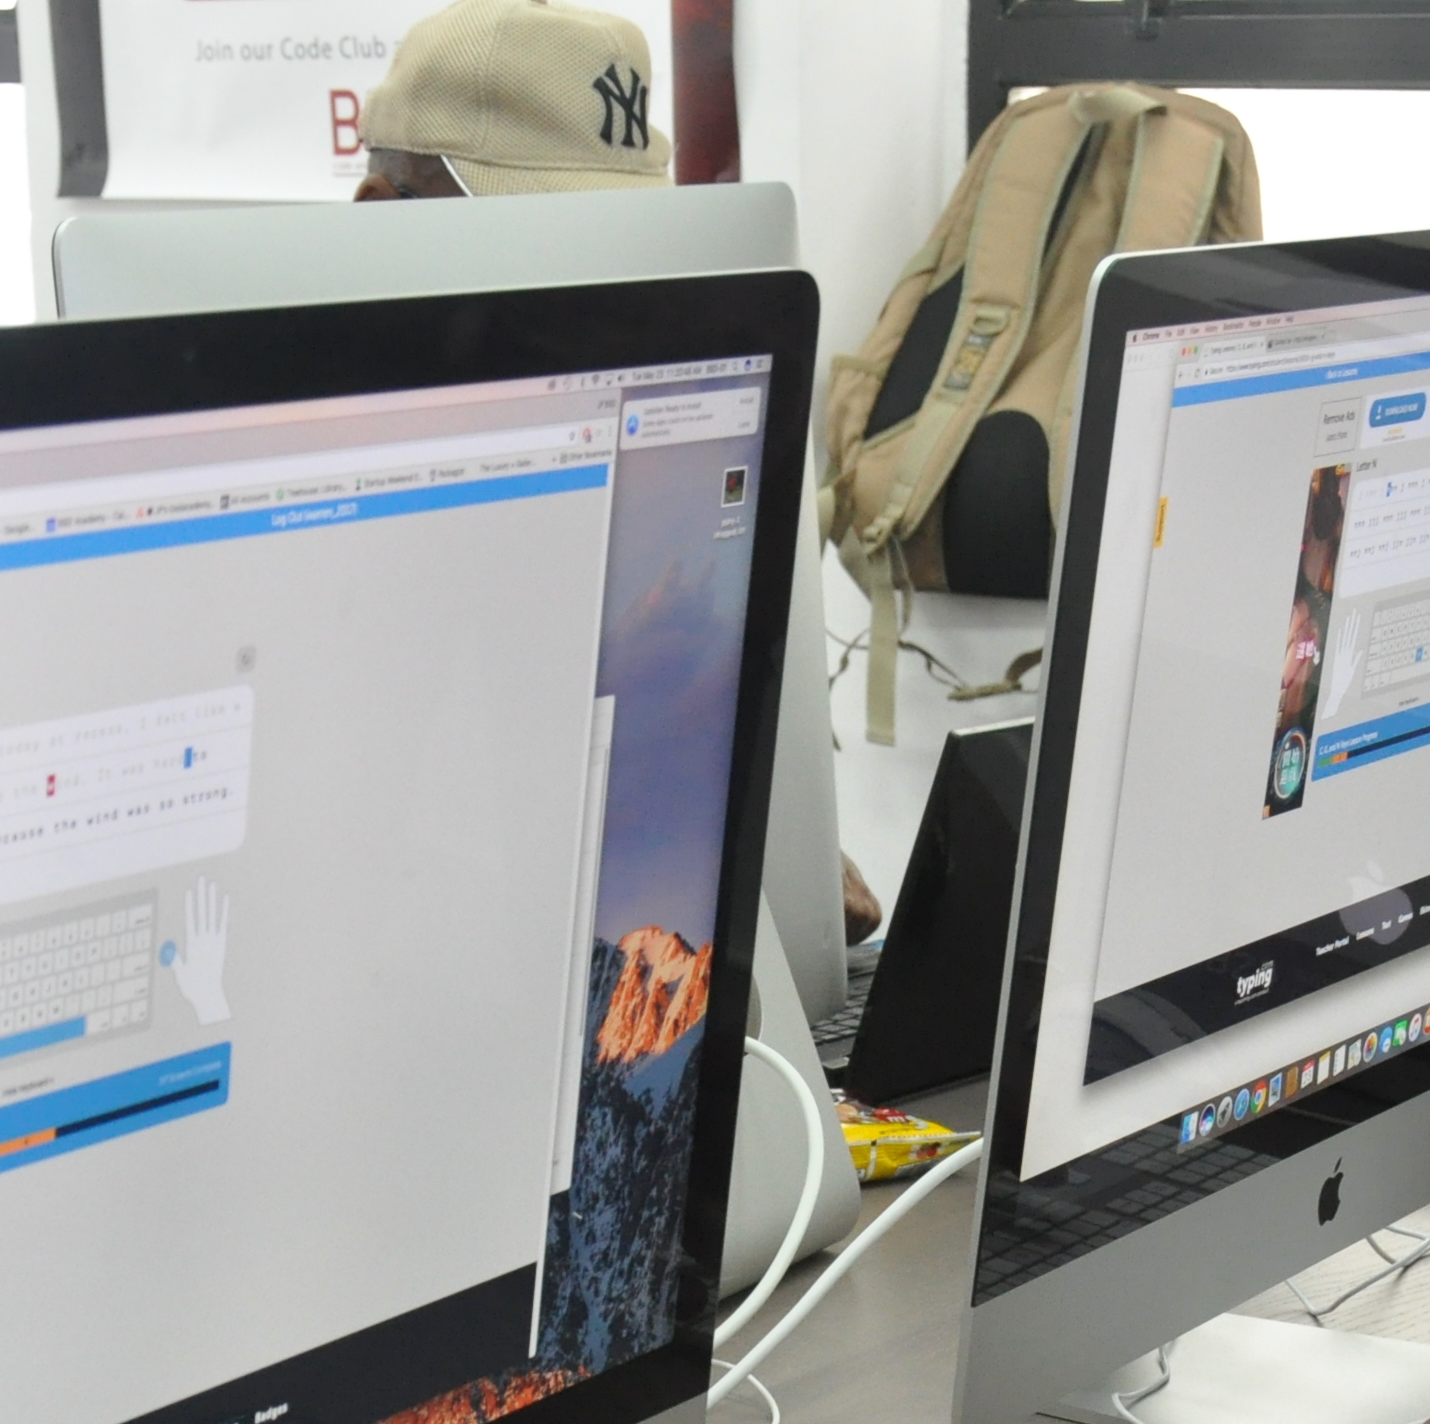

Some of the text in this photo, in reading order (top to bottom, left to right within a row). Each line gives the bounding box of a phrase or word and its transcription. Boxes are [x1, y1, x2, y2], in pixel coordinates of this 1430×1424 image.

[196, 39, 234, 63] Join
[239, 41, 272, 61] our
[279, 36, 333, 60] Code
[338, 34, 388, 60] Club
[592, 62, 650, 151] NY
[1323, 410, 1356, 425] Remove Ads
[54, 818, 78, 835] the
[86, 809, 119, 827] wind
[126, 804, 151, 818] was
[158, 799, 174, 812] so
[182, 787, 235, 806] strong.
[1315, 943, 1334, 957] Teacher
[1334, 935, 1350, 949] Portal
[1355, 927, 1375, 940] Lessons
[1382, 919, 1392, 930] Test
[1397, 911, 1414, 924] Games
[1236, 967, 1273, 998] typing
